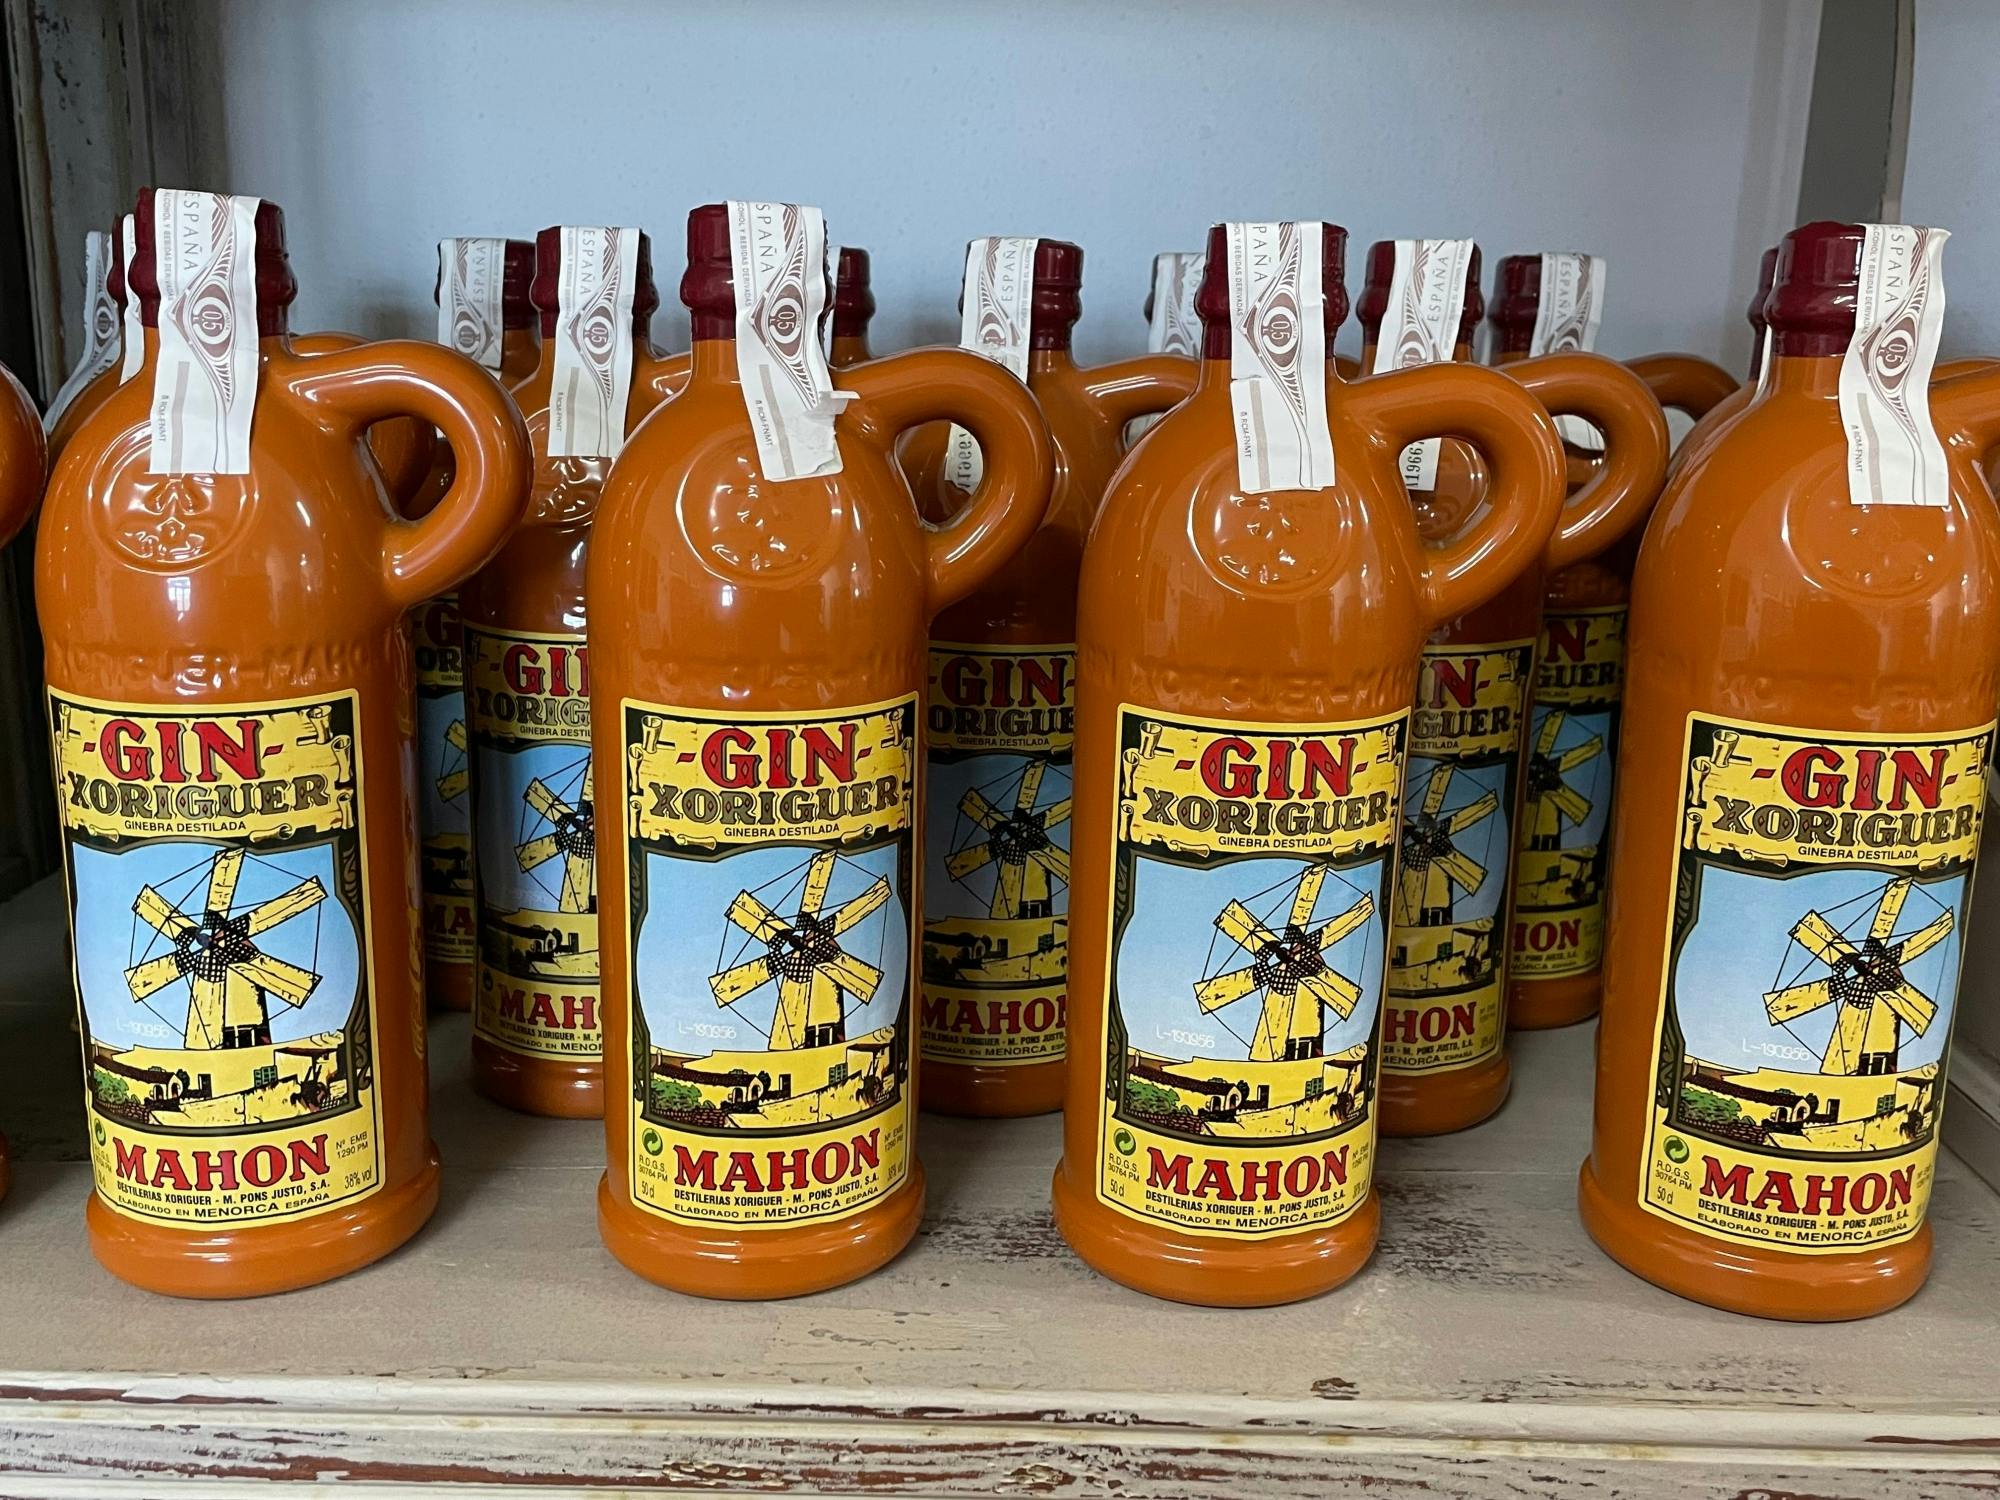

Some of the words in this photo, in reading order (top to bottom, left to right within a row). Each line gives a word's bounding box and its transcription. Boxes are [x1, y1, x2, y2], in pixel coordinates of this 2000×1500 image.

[183, 191, 202, 271] ESPAÑA
[737, 202, 748, 227] COHOL
[756, 203, 777, 273] SPAÑA
[1252, 225, 1272, 283] PAÑA
[579, 229, 596, 295] ESPAÑA
[1425, 255, 1449, 323] ESPAÑA
[1557, 261, 1572, 320] ESPAÑA
[560, 727, 591, 737] DESTIL
[928, 704, 1074, 737] ORIGUE
[1411, 705, 1510, 739] GUER
[1000, 737, 1050, 747] DESTILADA
[68, 770, 330, 819] XORIGUER
[649, 774, 900, 825] XORIGUER
[124, 819, 174, 832] GINEBRA
[176, 820, 247, 833] DESTILADA
[1142, 790, 1388, 837] XORIGUER
[1712, 795, 1975, 847] XORIGUER
[724, 825, 776, 838] GINEBRA
[778, 824, 840, 838] DESTILADA
[1218, 835, 1270, 848] GINEBRA
[1273, 835, 1333, 849] DESTILADA
[1797, 845, 1854, 860] GINEBRA
[1857, 847, 1919, 860] DESTILADA
[498, 984, 601, 1030] MAH
[1384, 1002, 1477, 1044] HON
[560, 1043, 602, 1051] MENO
[985, 1045, 1047, 1056] MENORCA
[112, 1133, 331, 1192] MAHON
[673, 1127, 881, 1193] MAHON
[1128, 1170, 1140, 1183] PM
[1146, 1144, 1350, 1203] MAHON
[117, 1180, 162, 1203] DESTILERIAS
[164, 1193, 212, 1207] XORIGUER
[223, 1194, 237, 1205] M.
[240, 1190, 268, 1204] PONS
[271, 1185, 307, 1201] JUSTO,
[310, 1181, 331, 1193] S.A.
[674, 1188, 731, 1207] DESTILERIAS
[734, 1195, 783, 1207] XORIGUER
[793, 1191, 805, 1203] M.
[808, 1188, 833, 1202] PONS
[835, 1178, 863, 1197] JUSTO,
[865, 1172, 880, 1185] S.A.
[1110, 1178, 1119, 1196] 50
[1656, 1185, 1666, 1202] 50
[1678, 1178, 1692, 1191] PM
[1700, 1154, 1915, 1217] MAHON
[118, 1194, 172, 1215] ELABORADO
[175, 1208, 190, 1217] EN
[194, 1202, 279, 1218] MENORCA
[285, 1192, 330, 1210] ESPAÑA
[674, 1203, 740, 1219] ELABORADO
[744, 1210, 760, 1219] EN
[764, 1200, 842, 1218] MENORCA
[845, 1186, 879, 1205] ESPAÑA
[1145, 1189, 1203, 1212] DESTILERIAS
[1205, 1203, 1254, 1216] XORIGUER
[1264, 1202, 1277, 1215] M.
[1279, 1202, 1302, 1214] PONS
[1145, 1204, 1210, 1225] ELABORADO
[1215, 1218, 1231, 1227] EN
[1235, 1212, 1309, 1228] MENORCA
[1313, 1202, 1345, 1219] ESPAÑA
[1698, 1198, 1762, 1223] DESTILERIAS
[1765, 1215, 1817, 1230] XORIGUER
[1827, 1218, 1839, 1230] M.
[1842, 1217, 1866, 1230] PONS
[1697, 1212, 1769, 1236] ELABORADO
[1775, 1231, 1791, 1240] EN
[1796, 1230, 1873, 1242] MENORCA
